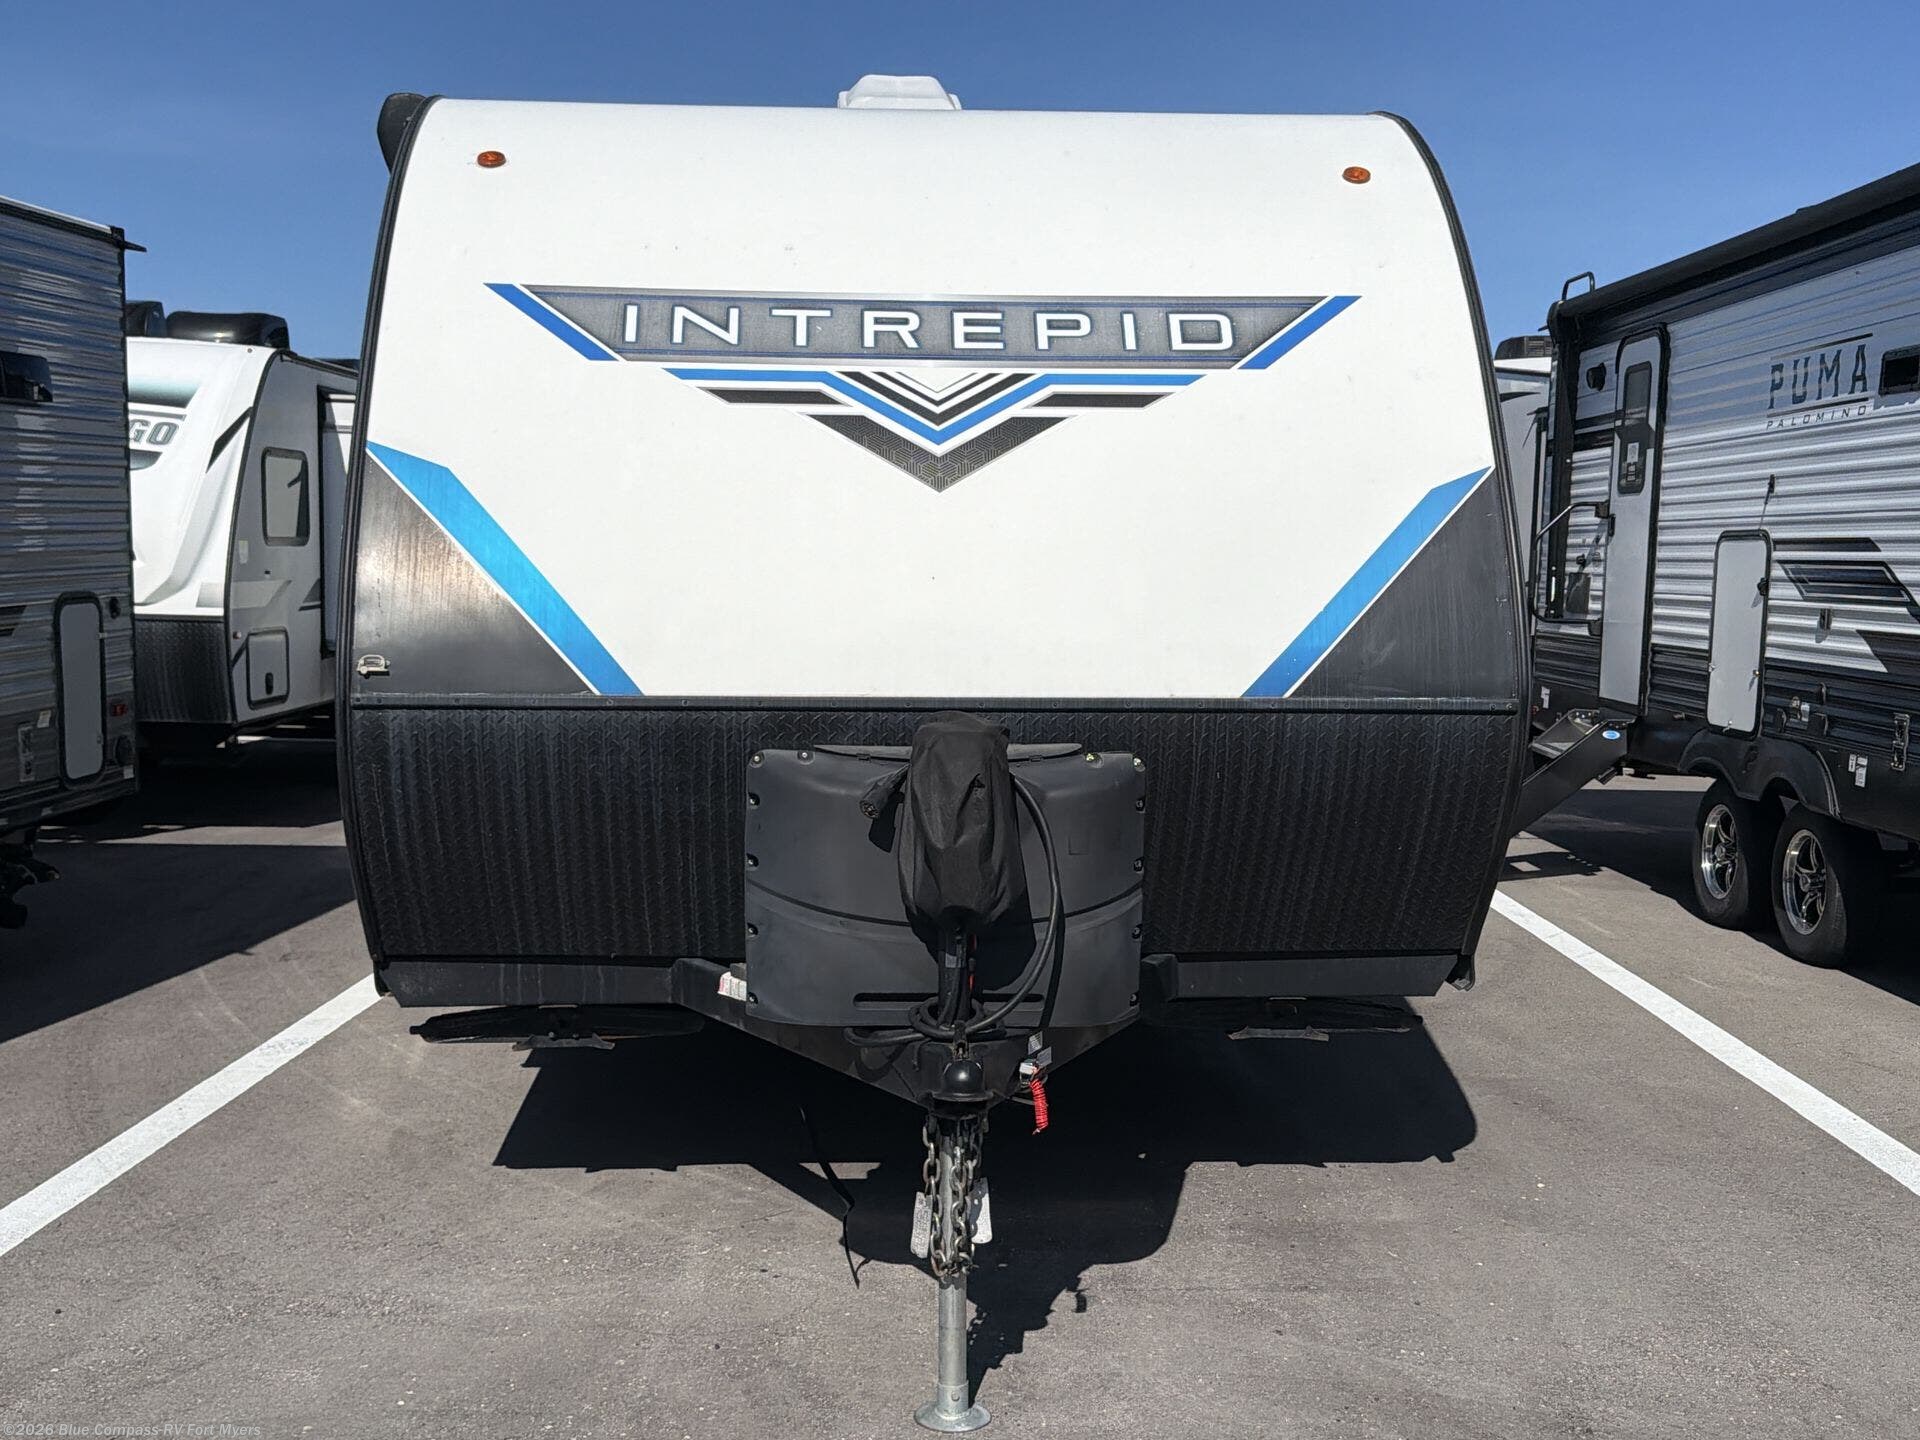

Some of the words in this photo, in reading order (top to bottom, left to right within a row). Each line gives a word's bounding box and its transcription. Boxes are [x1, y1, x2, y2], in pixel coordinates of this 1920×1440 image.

[623, 303, 1235, 352] INTREPID
[1767, 343, 1868, 410] PUMA
[1766, 405, 1867, 430] PALOMINO
